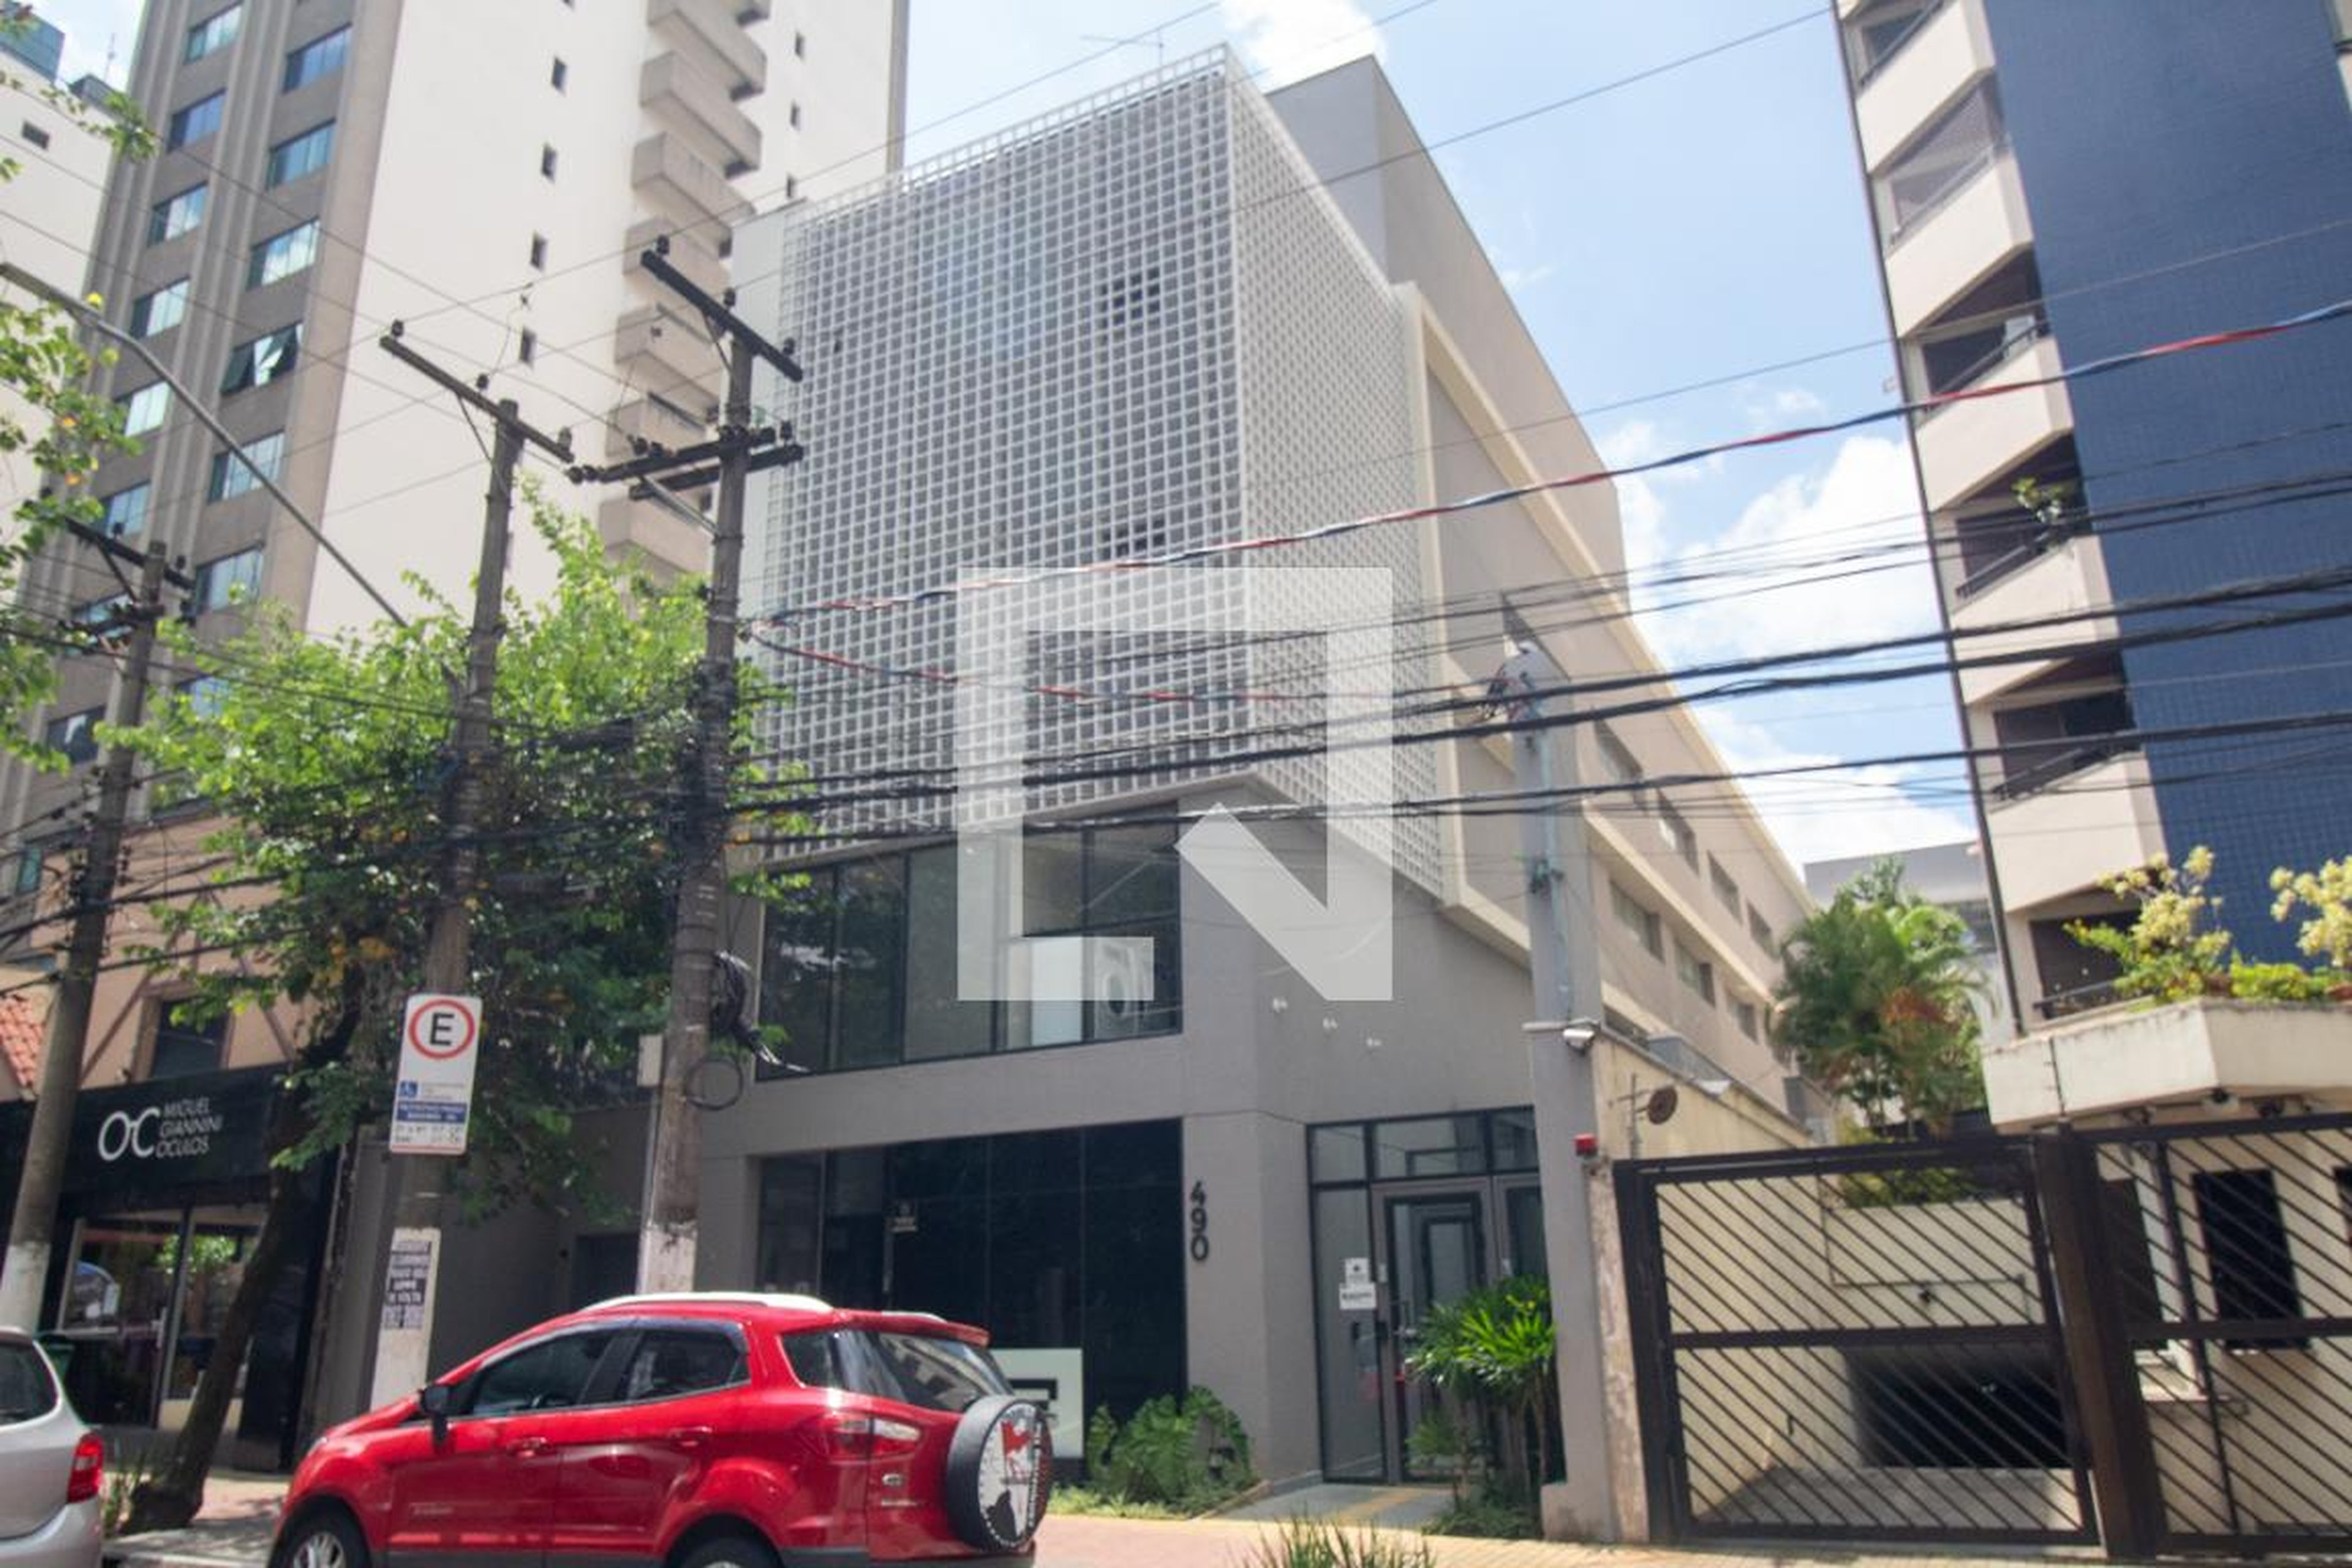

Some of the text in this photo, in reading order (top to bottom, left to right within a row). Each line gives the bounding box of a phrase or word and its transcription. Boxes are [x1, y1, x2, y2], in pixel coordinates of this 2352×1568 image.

[430, 1012, 454, 1046] E
[98, 1107, 160, 1161] OC
[1190, 1180, 1208, 1261] 490
